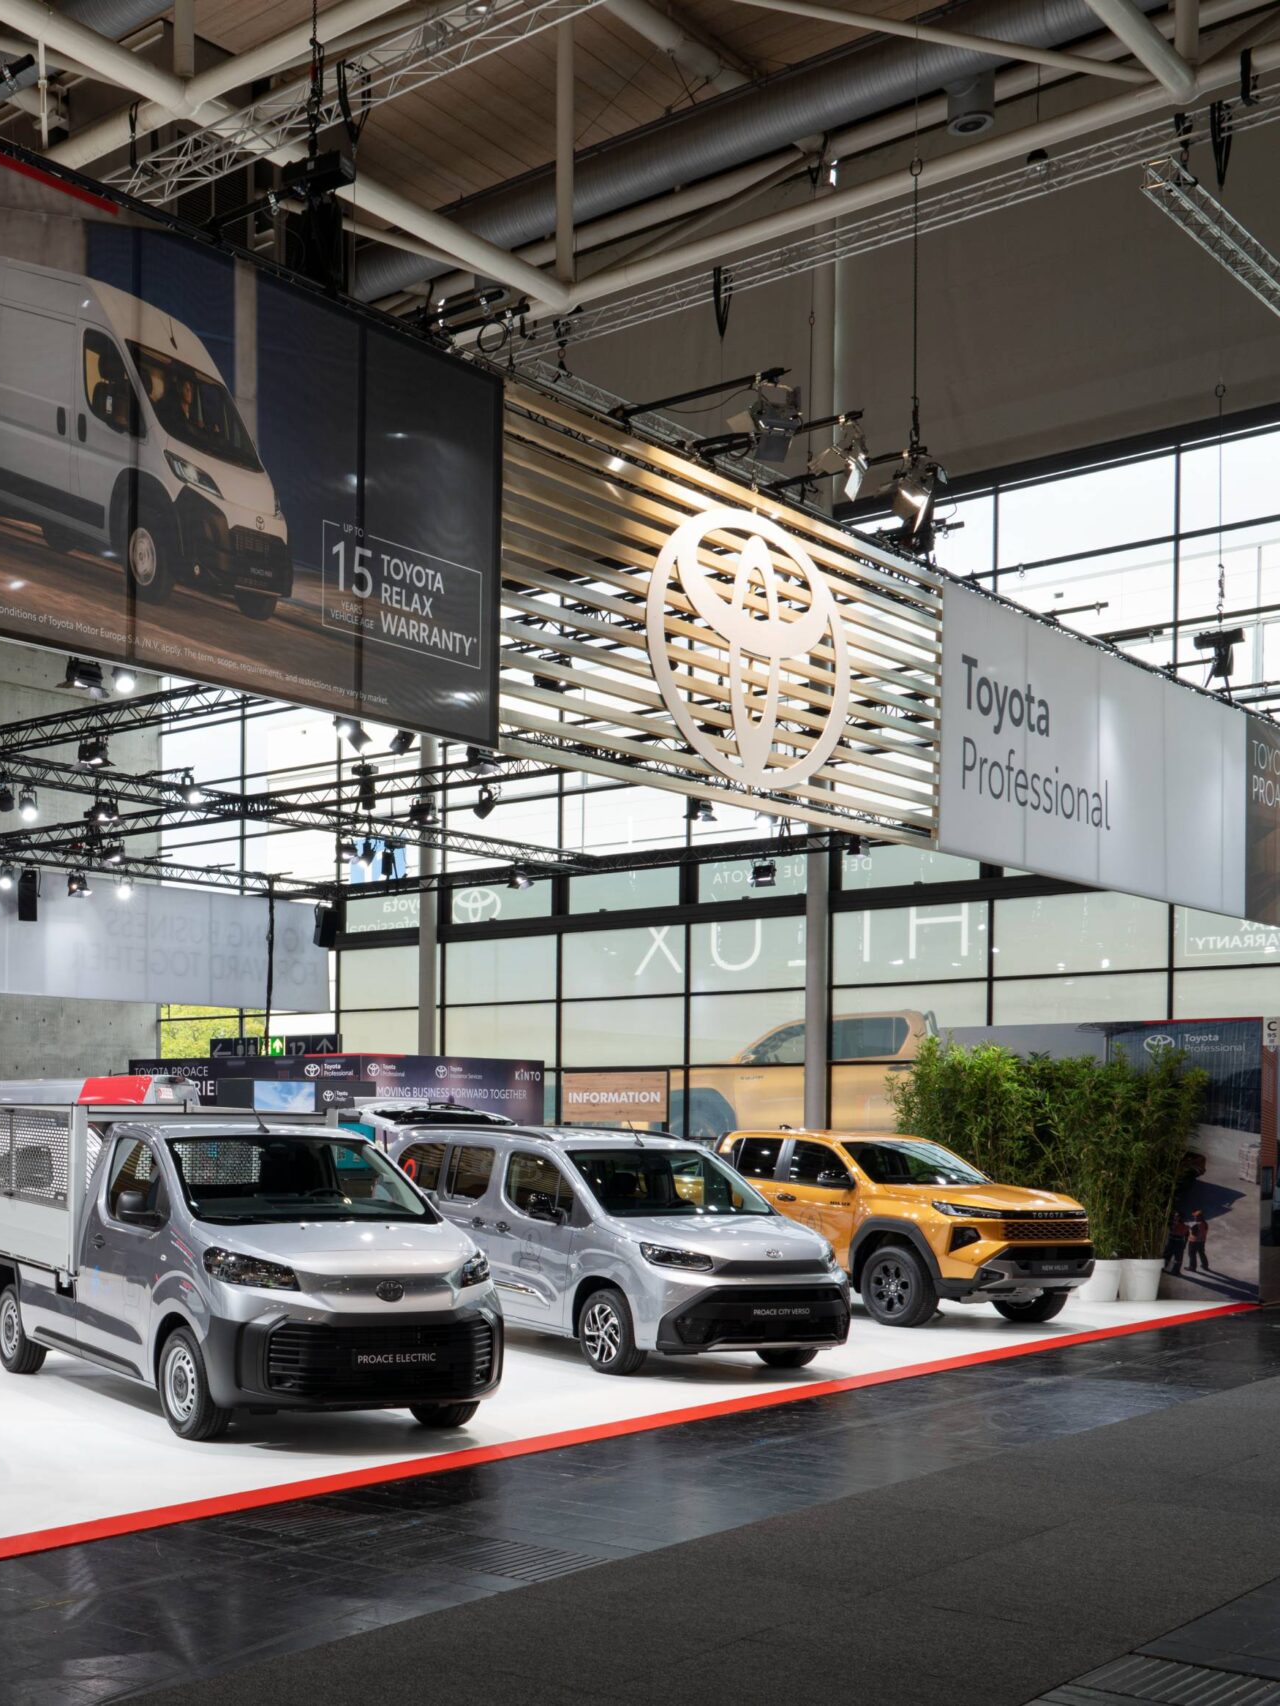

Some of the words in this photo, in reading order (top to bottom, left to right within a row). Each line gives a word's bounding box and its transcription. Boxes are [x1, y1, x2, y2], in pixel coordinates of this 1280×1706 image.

[343, 523, 353, 534] UP
[354, 526, 364, 537] TO
[332, 540, 373, 599] 15
[380, 554, 445, 595] TOYOTA
[341, 600, 363, 616] YEARS
[381, 583, 433, 619] RELAX
[330, 608, 359, 625] VEHICLE
[360, 618, 375, 630] AGE
[38, 613, 49, 624] of
[48, 615, 74, 631] Toyota
[75, 622, 99, 636] Motor
[100, 627, 127, 643] Europe
[184, 648, 197, 659] The
[286, 674, 298, 683] and
[962, 653, 1050, 737] Toyota
[1252, 739, 1280, 775] TOYO
[962, 736, 1111, 831] Professional
[1184, 1033, 1220, 1043] Toyota
[289, 1041, 306, 1056] 12
[1184, 1043, 1246, 1053] Professional
[134, 1067, 169, 1077] TOYOTA
[171, 1065, 209, 1077] PROACE
[376, 1085, 411, 1098] MOVING
[412, 1086, 450, 1098] BUSINESS
[451, 1087, 489, 1099] FORWARD
[489, 1088, 528, 1100] TOGETHER
[568, 1091, 661, 1104] INFORMATION
[357, 1353, 394, 1364] PROACE
[396, 1352, 437, 1363] ELECTRIC
